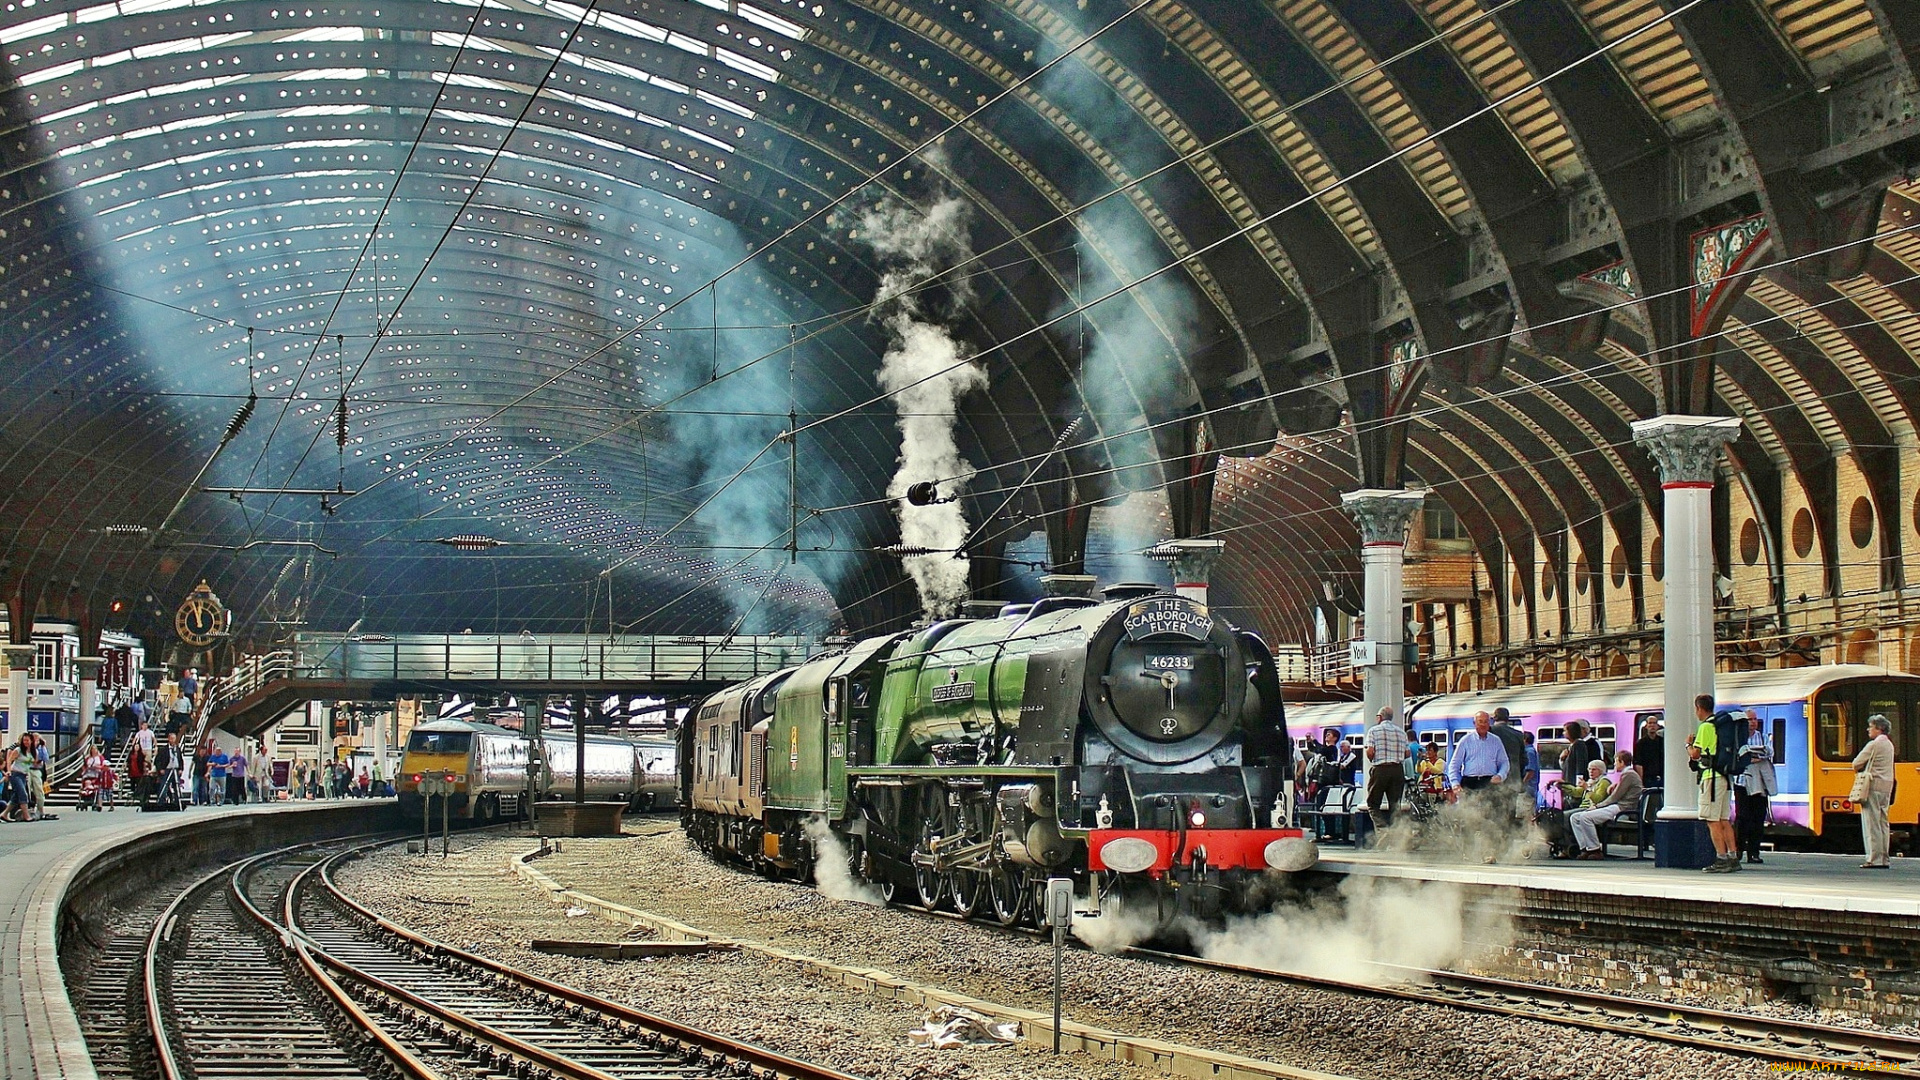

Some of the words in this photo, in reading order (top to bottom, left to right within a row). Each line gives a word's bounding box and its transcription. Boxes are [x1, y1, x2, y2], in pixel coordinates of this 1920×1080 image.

[1155, 601, 1181, 611] THE
[1126, 610, 1212, 631] SCARBOROUGH
[1150, 621, 1188, 633] FLYER
[1353, 645, 1367, 659] York
[1151, 656, 1189, 668] 46233
